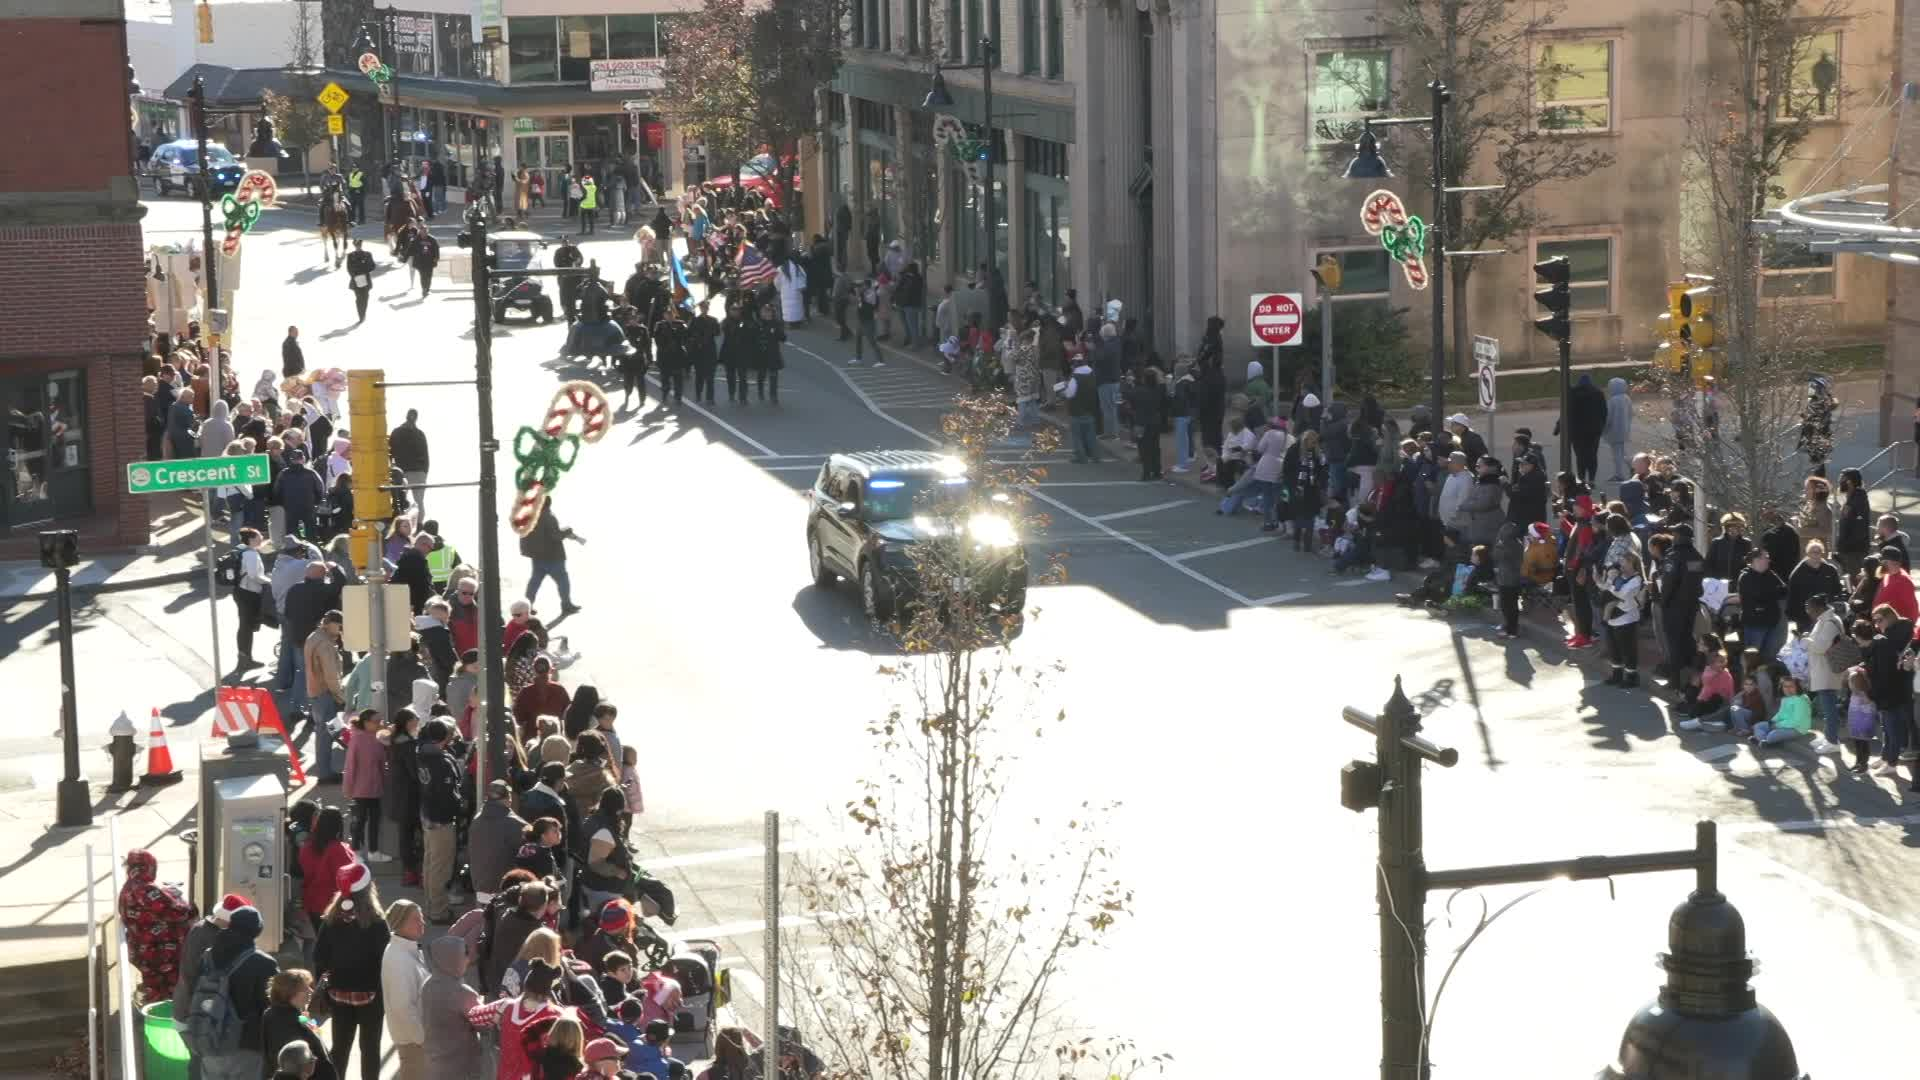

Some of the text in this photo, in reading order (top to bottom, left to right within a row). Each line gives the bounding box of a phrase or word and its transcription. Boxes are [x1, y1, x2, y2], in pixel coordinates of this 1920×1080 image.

[1259, 303, 1294, 313] DO NOT
[1262, 326, 1290, 336] ENTER
[155, 463, 237, 484] Crescent
[247, 465, 261, 478] St
